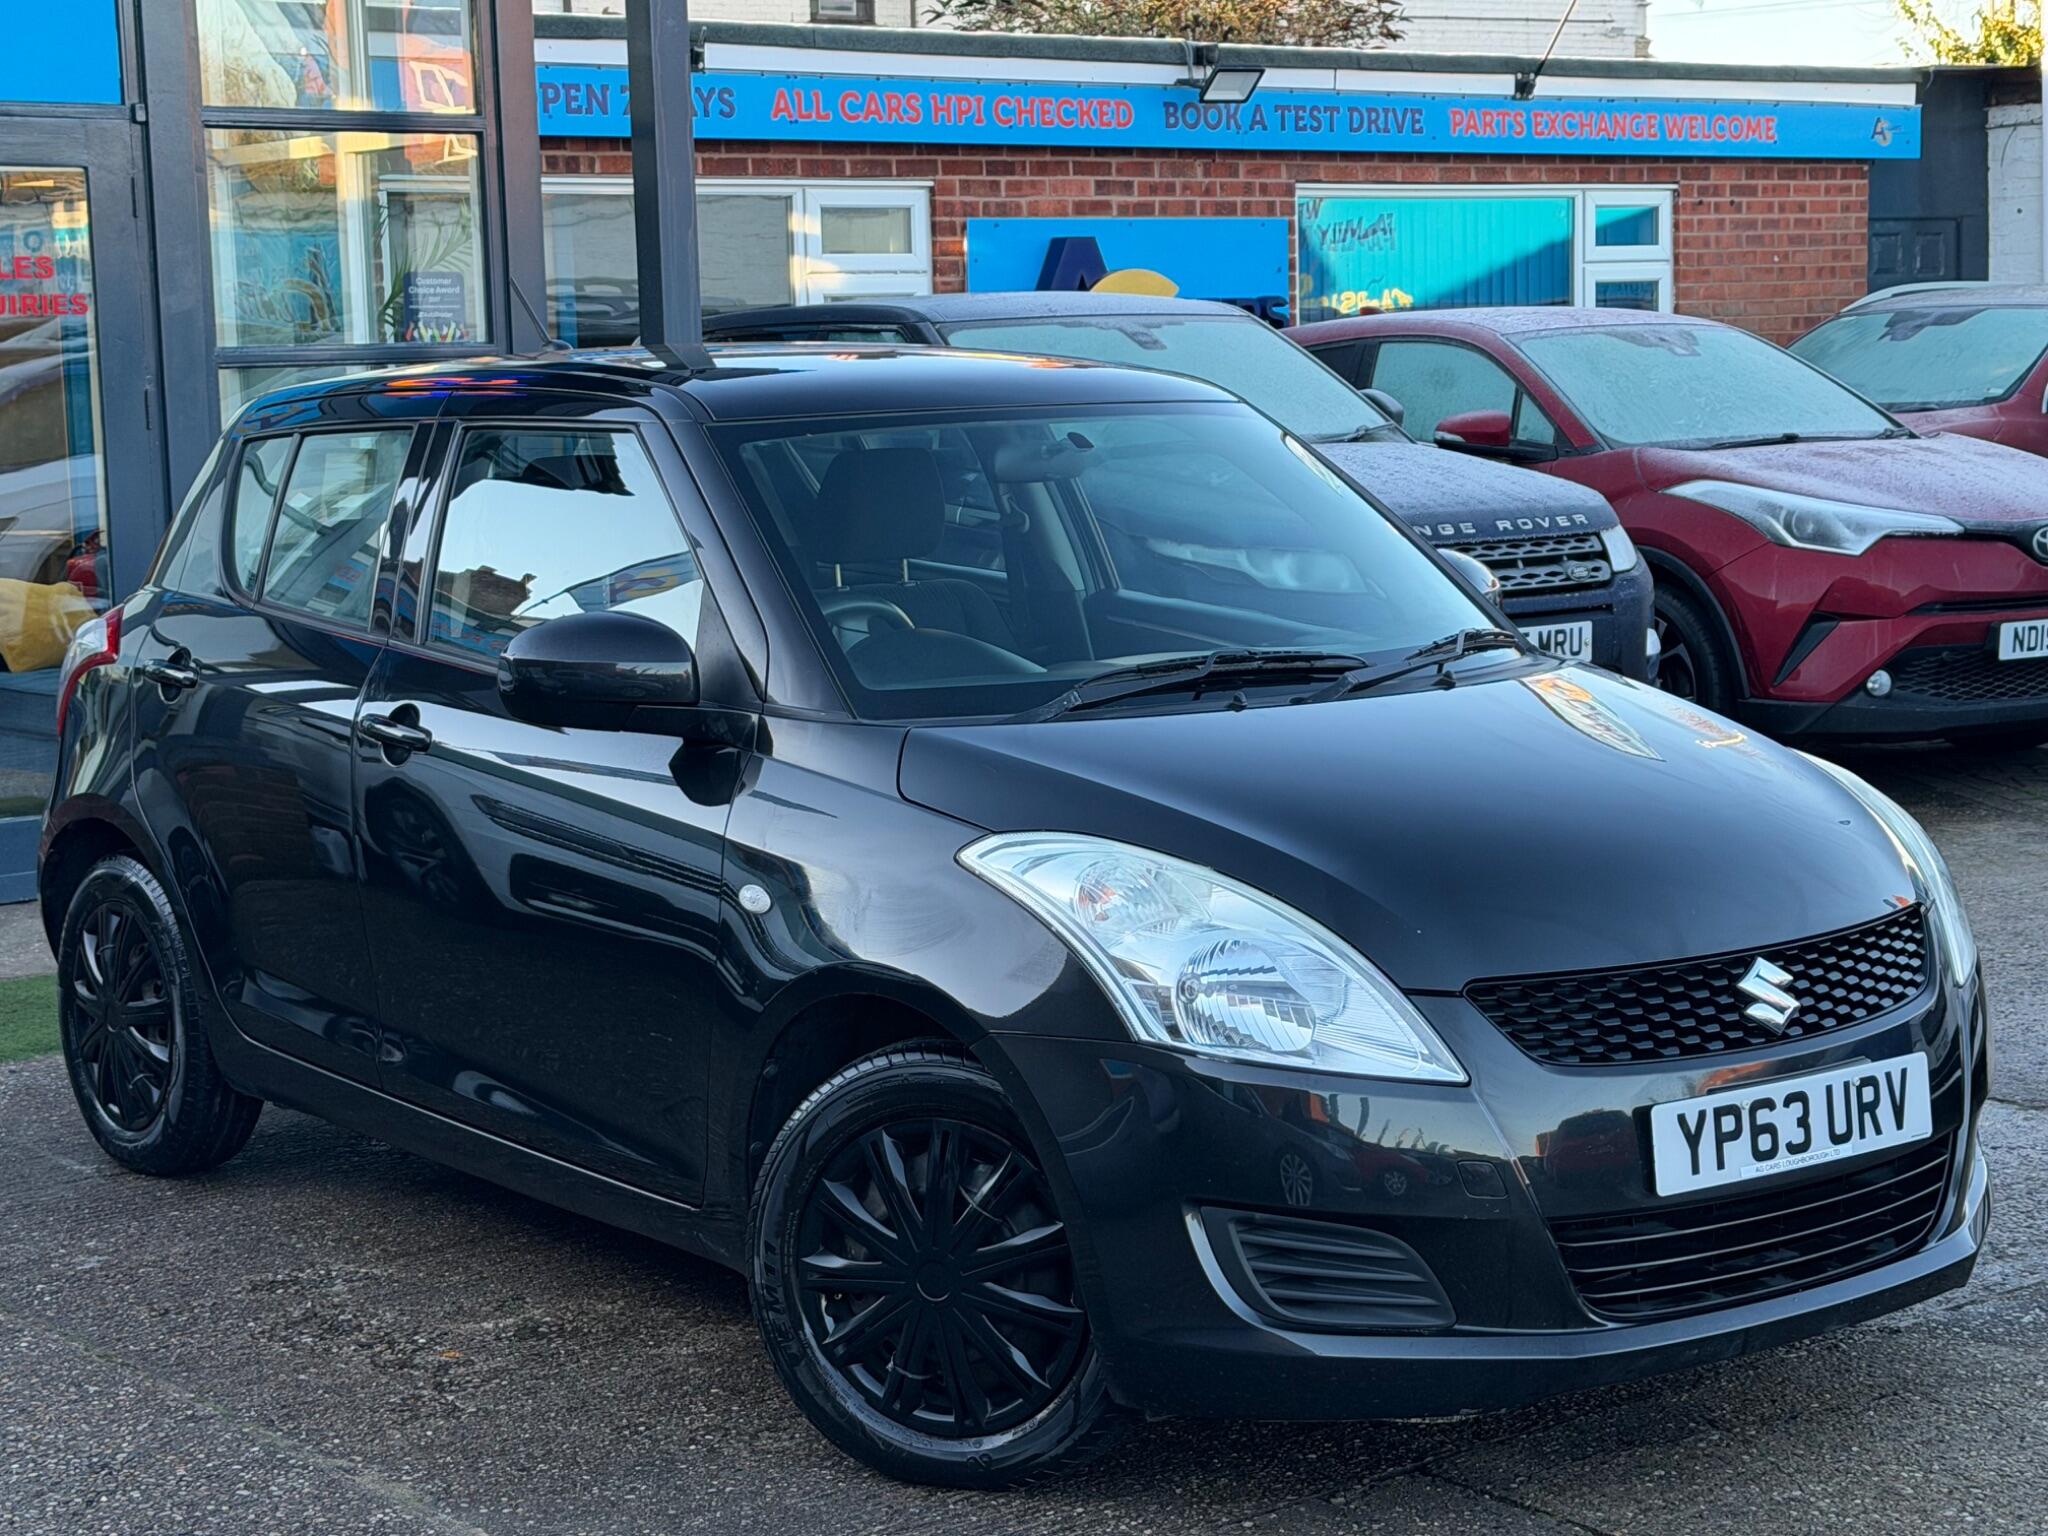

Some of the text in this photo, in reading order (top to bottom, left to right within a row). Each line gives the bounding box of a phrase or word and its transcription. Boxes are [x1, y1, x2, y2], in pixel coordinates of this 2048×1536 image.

[539, 82, 610, 116] PEN
[691, 87, 736, 118] YS
[771, 88, 1134, 129] ALL CARS HPI CHECKED
[1163, 101, 1425, 135] BOOK A TEST DRIVE
[1450, 109, 1778, 142] PARTS EXCHANGE WELCOME
[0, 255, 55, 280] LES
[408, 285, 460, 294] Choice Award
[1414, 513, 1589, 536] NGE ROVER
[1677, 1067, 1909, 1176] YP63 URV
[1765, 1162, 1783, 1172] CARS
[1782, 1151, 1830, 1168] LOUGHBOROUGH
